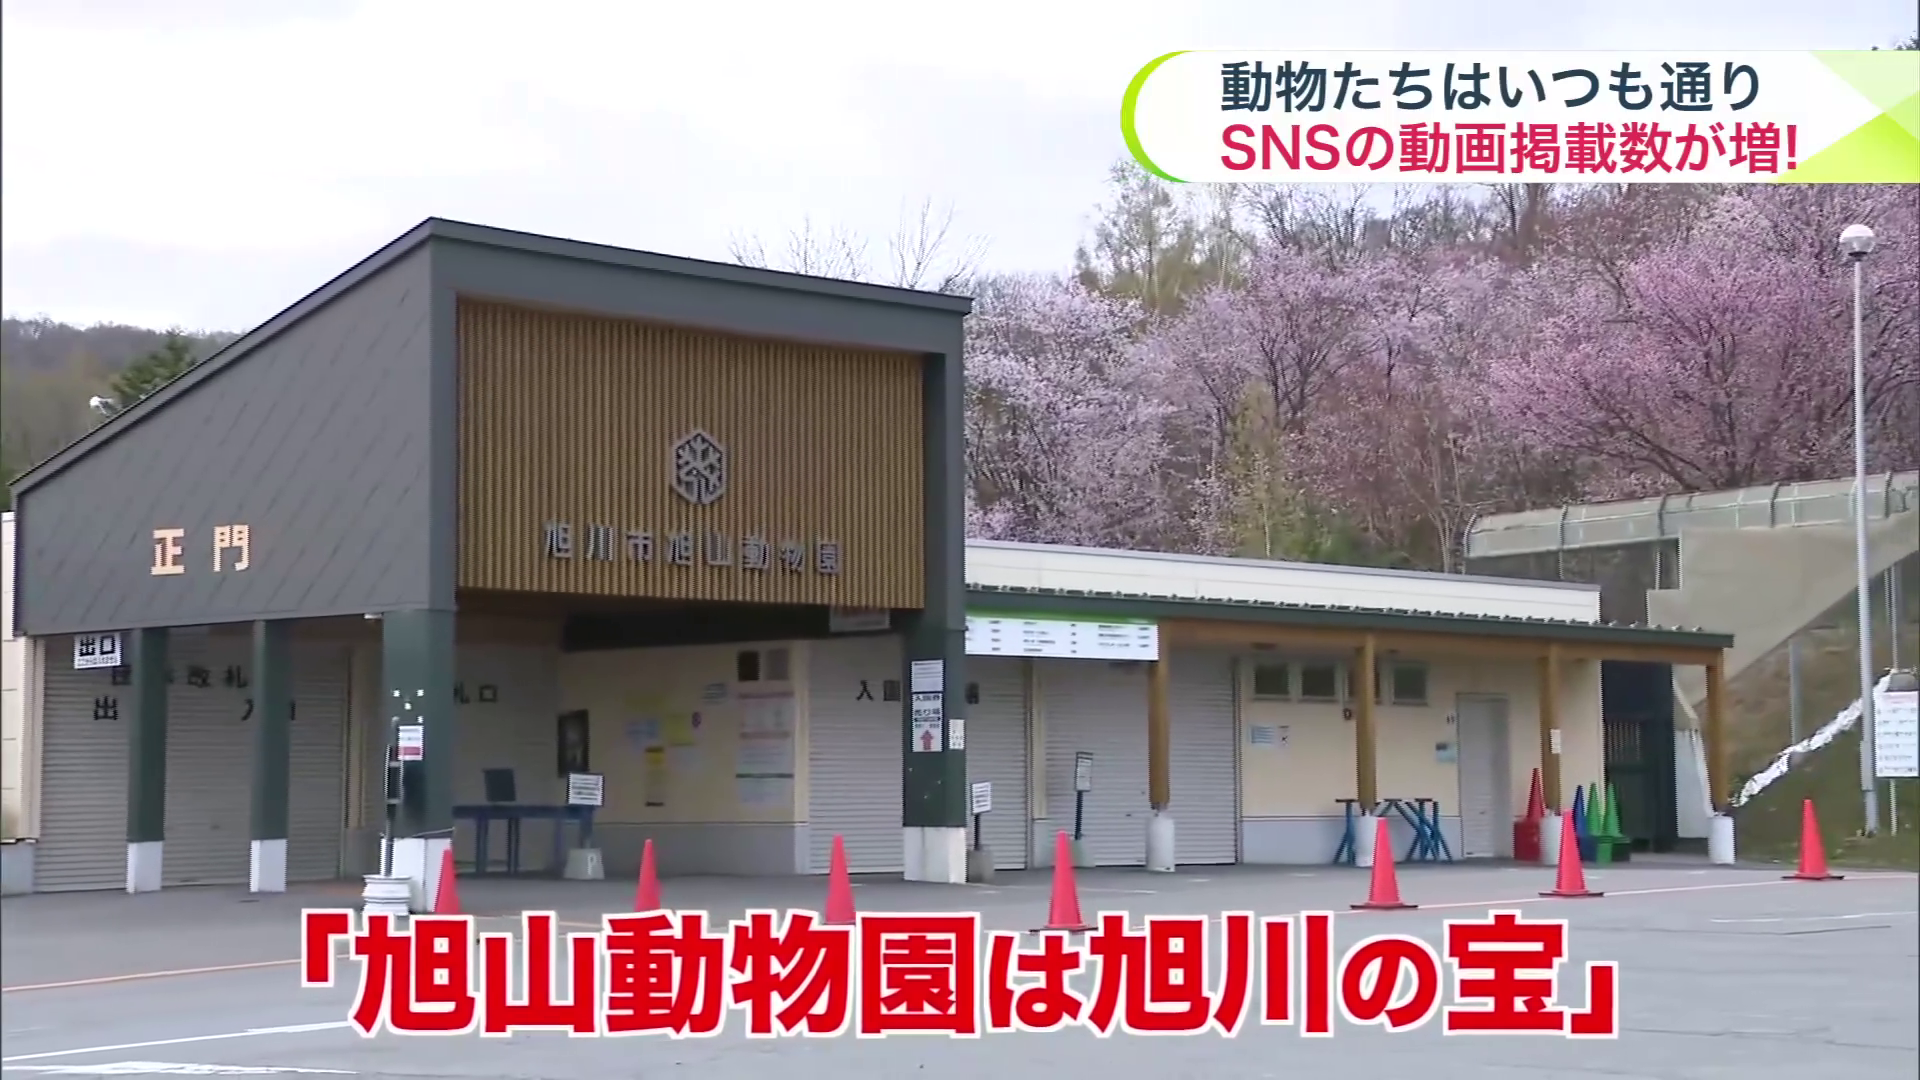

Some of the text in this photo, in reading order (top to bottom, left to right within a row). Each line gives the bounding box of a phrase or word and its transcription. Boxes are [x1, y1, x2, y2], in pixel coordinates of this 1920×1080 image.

[151, 524, 250, 575] 正門
[543, 520, 841, 575] 旭川市旭山動物園
[79, 636, 115, 657] 出口
